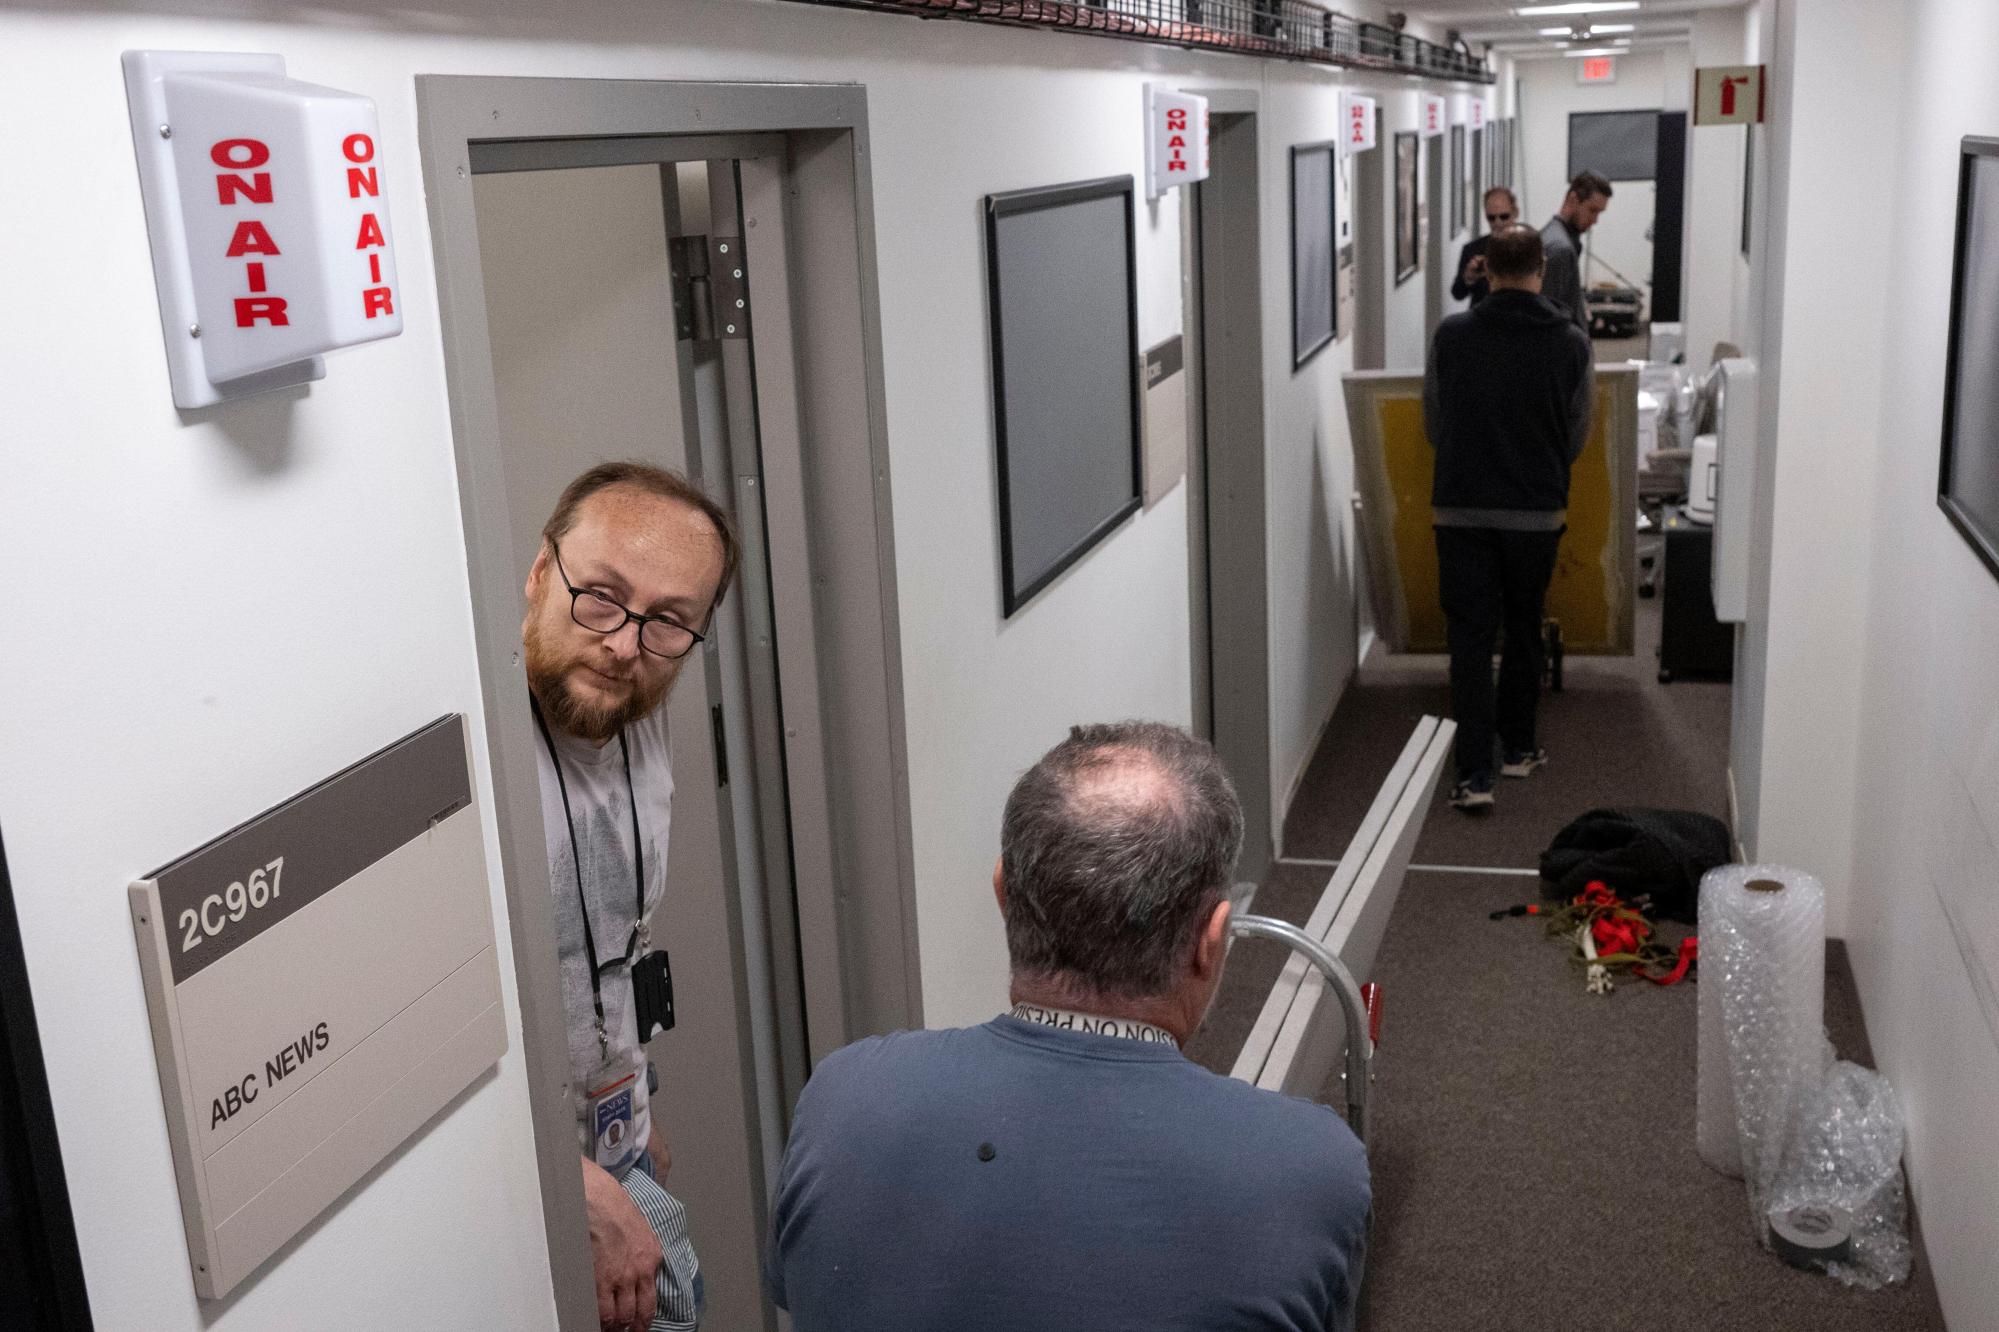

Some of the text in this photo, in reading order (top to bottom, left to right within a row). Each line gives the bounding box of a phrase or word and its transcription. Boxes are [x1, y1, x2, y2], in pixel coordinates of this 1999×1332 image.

[1167, 109, 1186, 171] ON AIR
[210, 138, 290, 327] ON AIR
[342, 133, 394, 319] ON AIR
[179, 856, 284, 953] 2C967
[211, 1021, 330, 1131] ABC NEWS
[1083, 1017, 1119, 1037] ON
